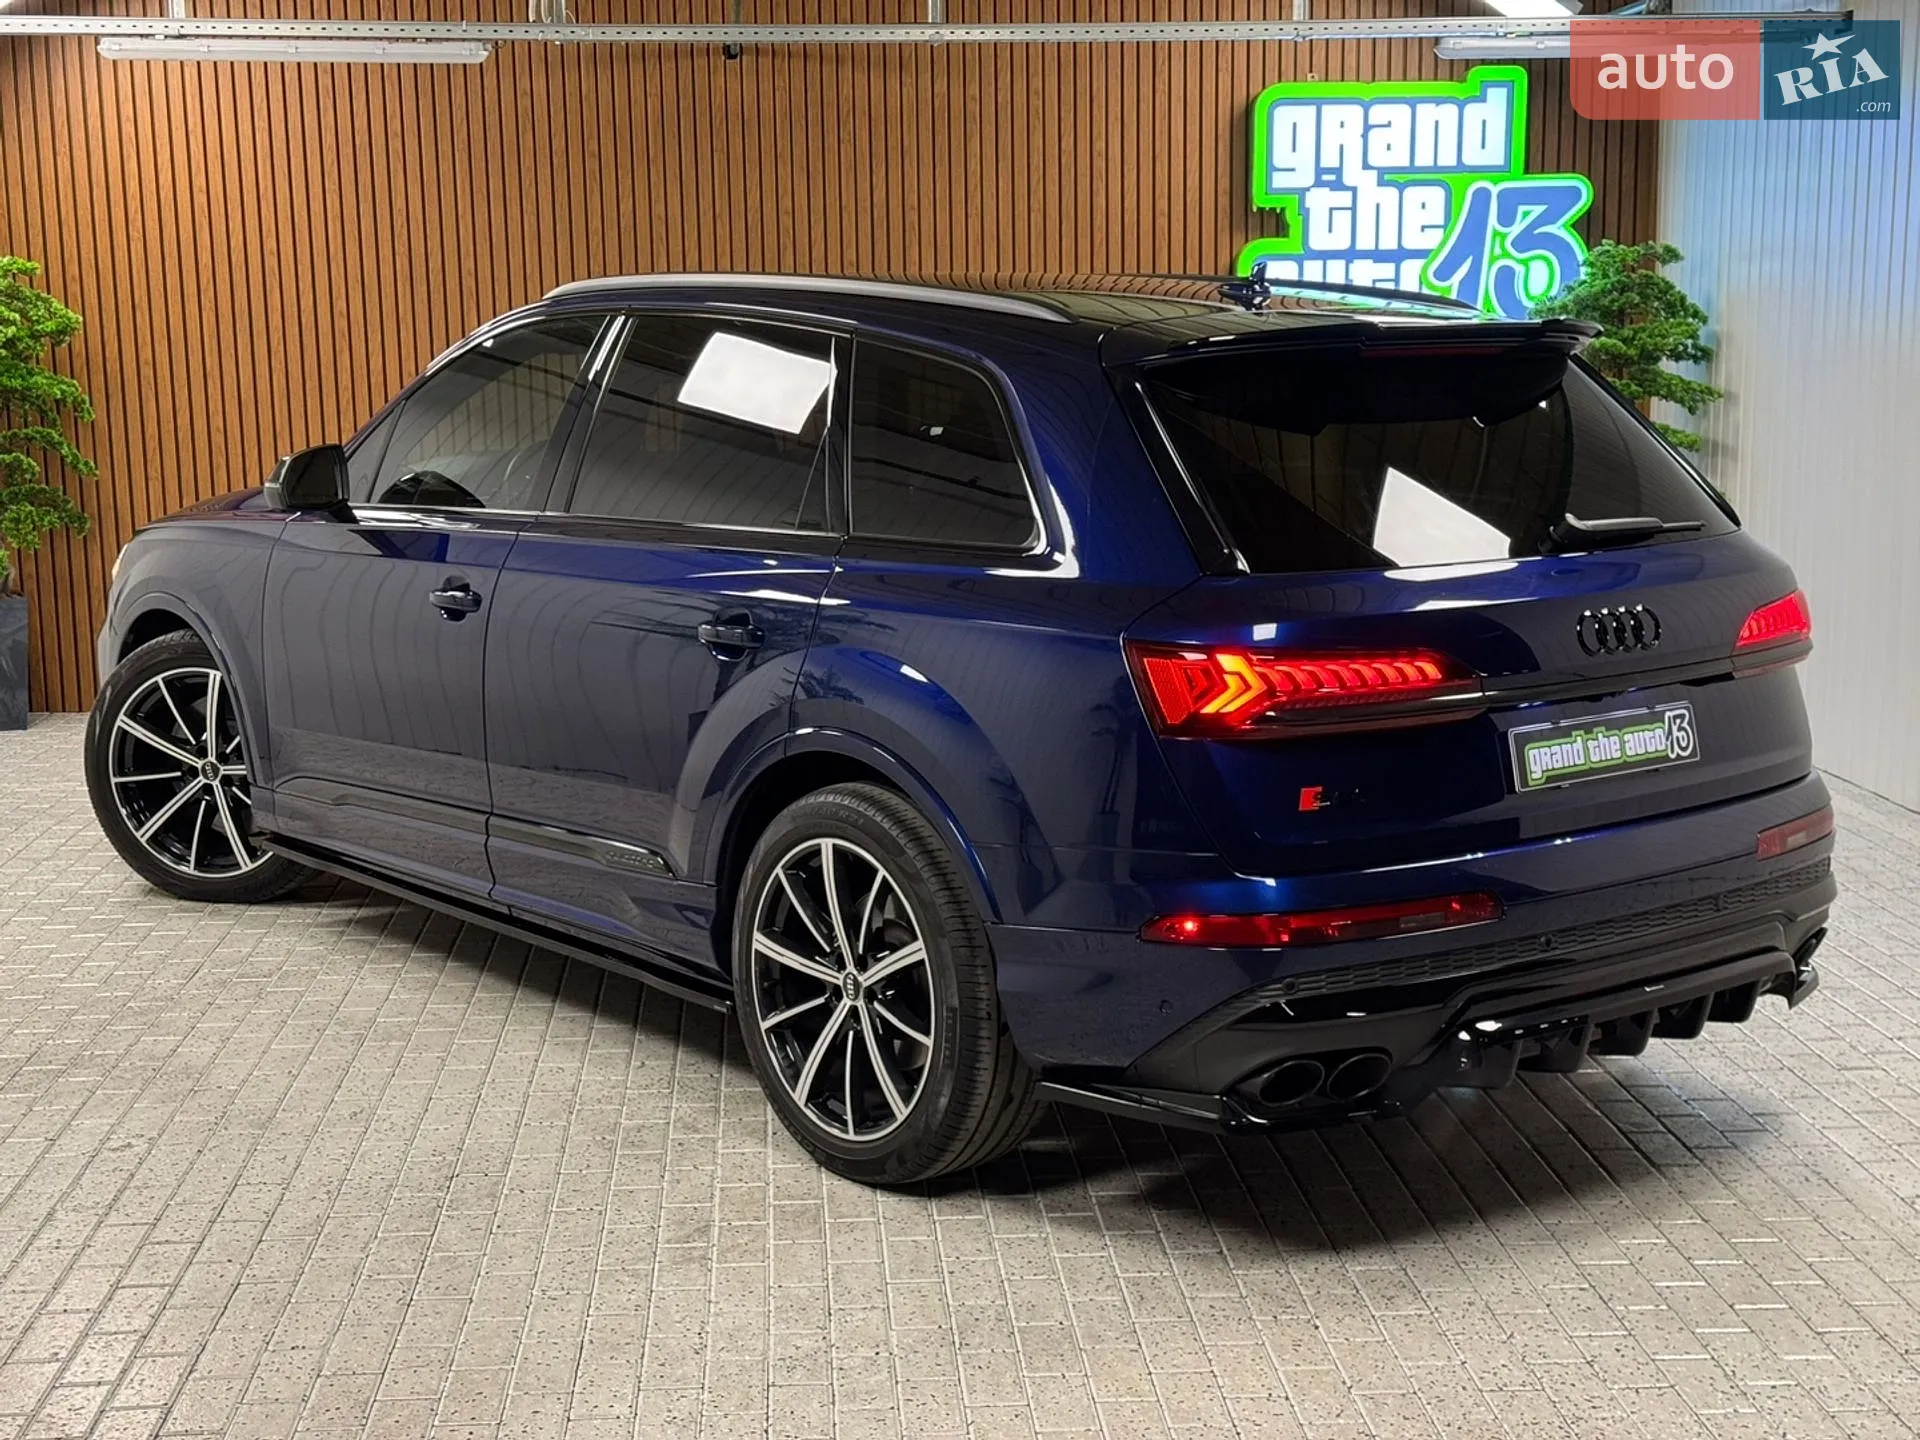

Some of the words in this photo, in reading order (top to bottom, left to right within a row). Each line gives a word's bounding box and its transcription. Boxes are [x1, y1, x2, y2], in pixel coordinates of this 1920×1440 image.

[1305, 169, 1446, 251] the
[1428, 180, 1589, 320] 13
[1587, 732, 1622, 763] the
[1623, 727, 1665, 757] auto
